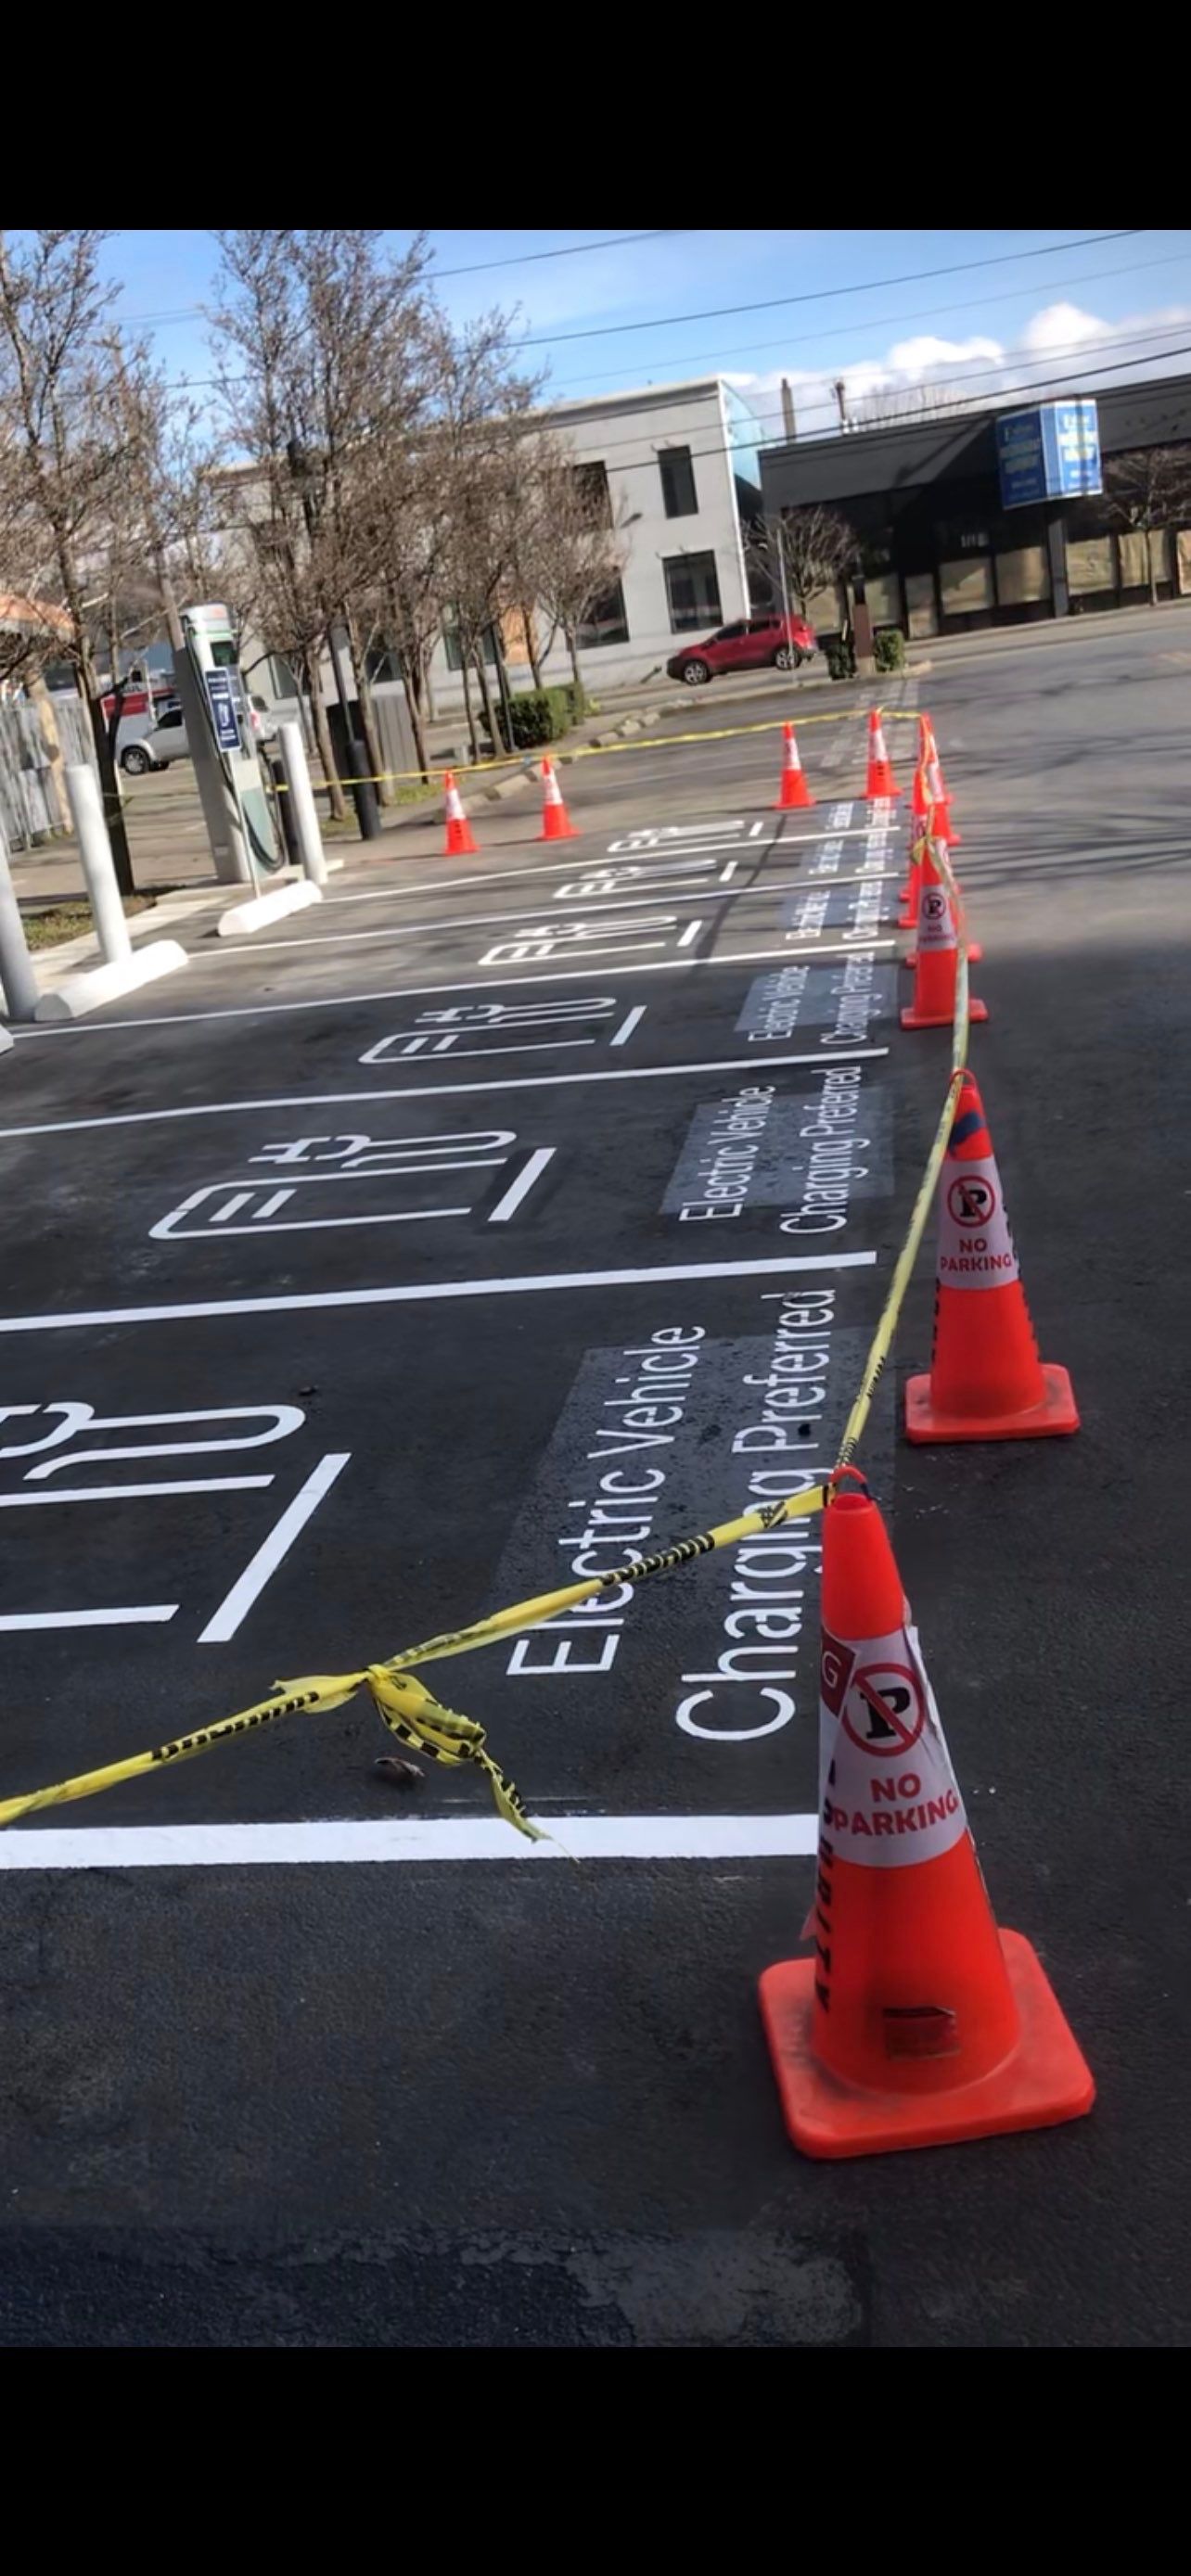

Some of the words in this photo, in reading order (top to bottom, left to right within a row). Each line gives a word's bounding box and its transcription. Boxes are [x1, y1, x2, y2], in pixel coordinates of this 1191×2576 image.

[708, 1085, 776, 1145] Vehicle
[800, 1065, 862, 1138] Preferred
[679, 1143, 760, 1221] Electric
[779, 1138, 872, 1234] Charging
[941, 1254, 1013, 1272] PARKING
[959, 1238, 987, 1253] NO
[733, 1289, 837, 1454] Preferred
[506, 1468, 666, 1677] Electric
[587, 1325, 706, 1459] Vehicle
[831, 1789, 959, 1836] PARKING
[870, 1772, 921, 1804] NO
